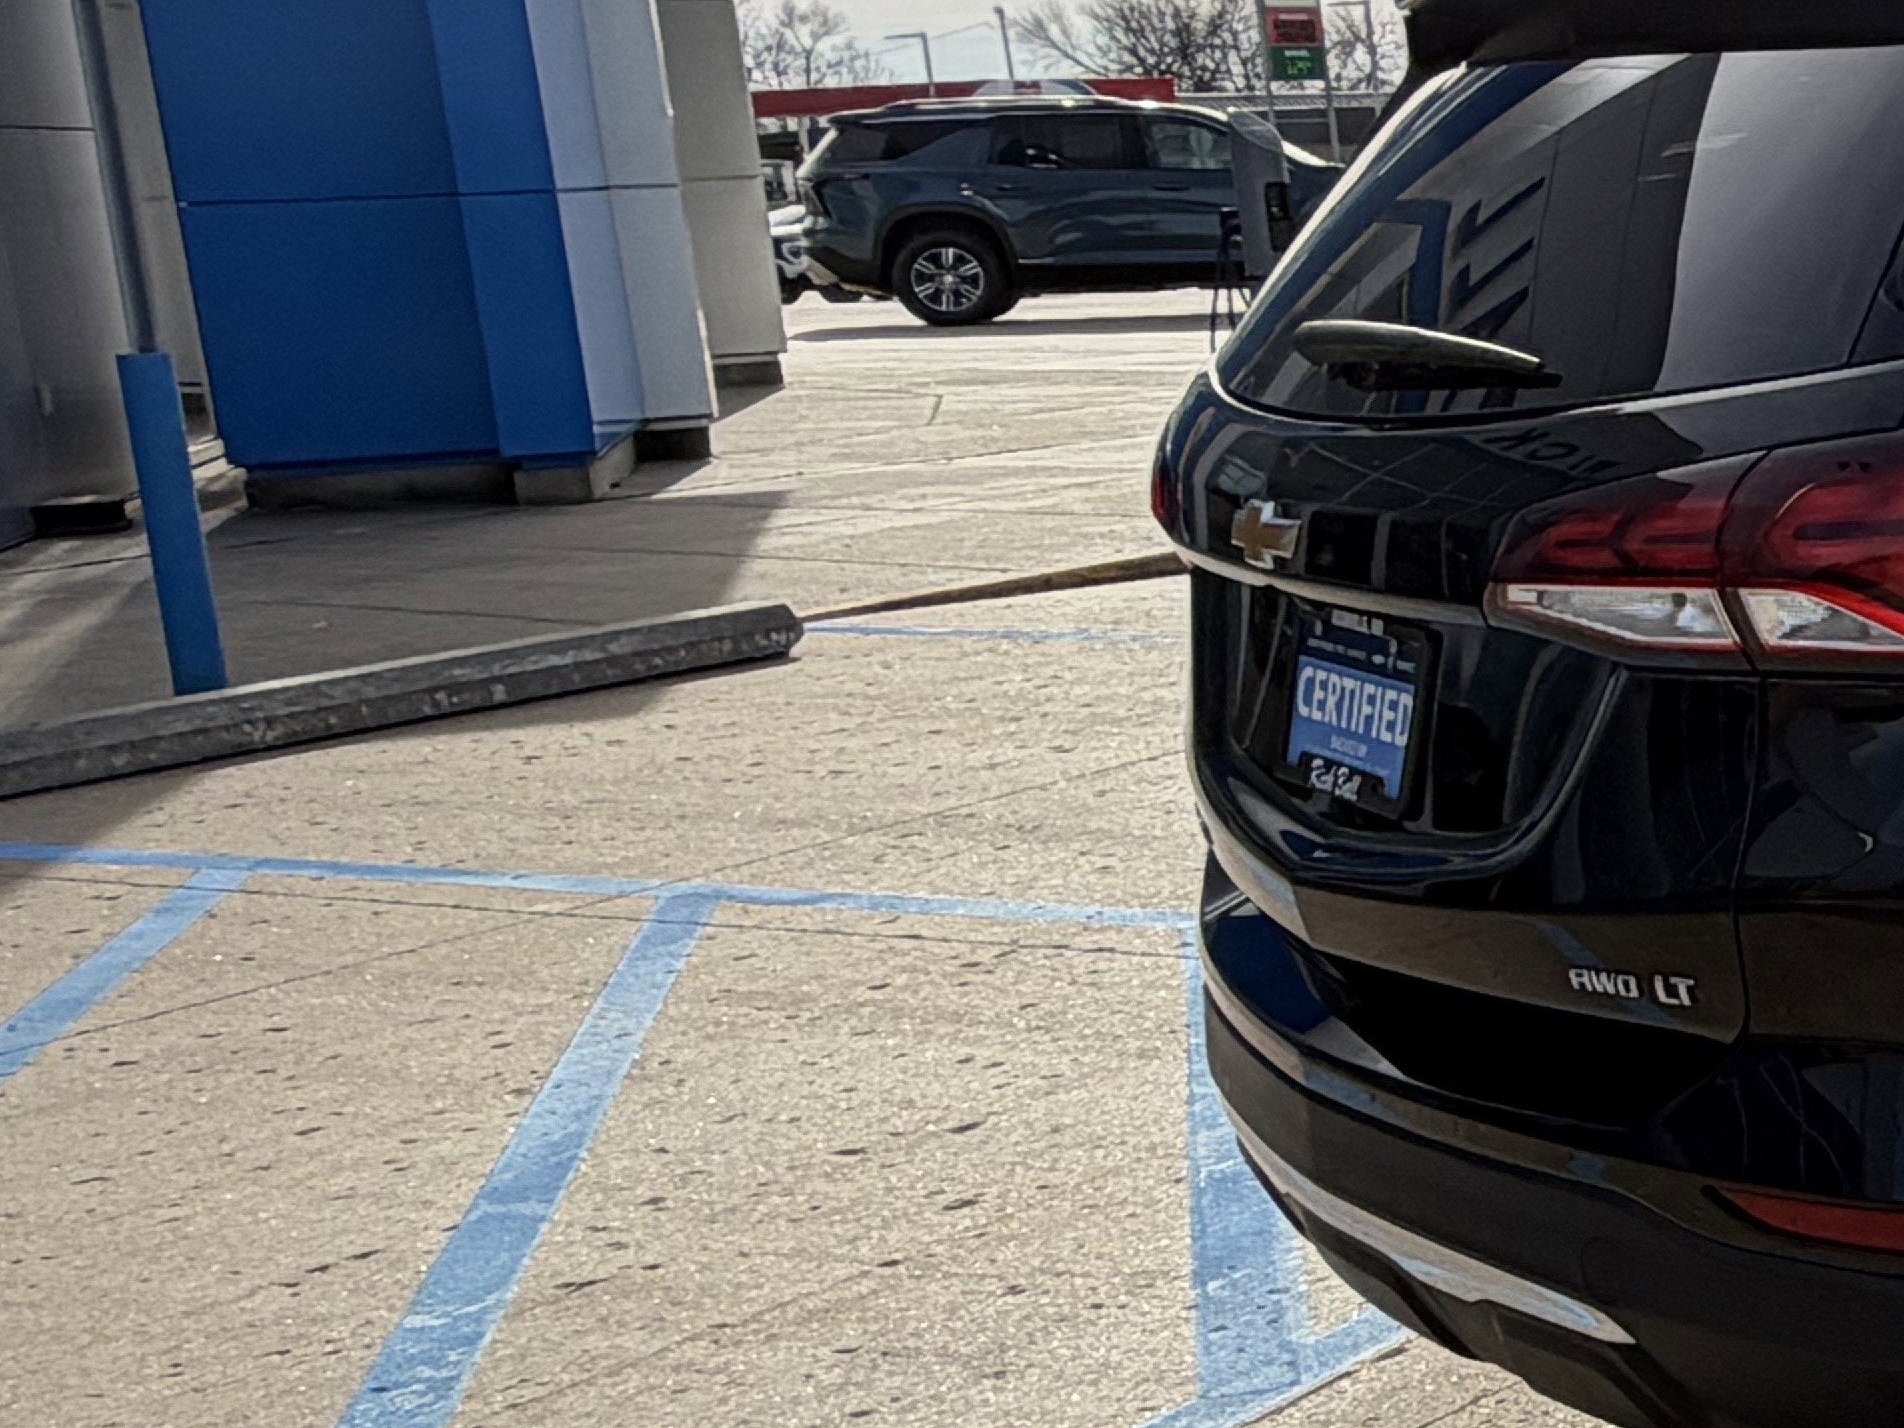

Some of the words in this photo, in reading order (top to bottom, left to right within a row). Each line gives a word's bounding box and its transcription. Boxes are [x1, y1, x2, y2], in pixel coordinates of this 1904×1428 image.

[1296, 665, 1415, 747] CERTIFIED
[1568, 968, 1640, 998] AWD
[1654, 974, 1695, 1006] LT
